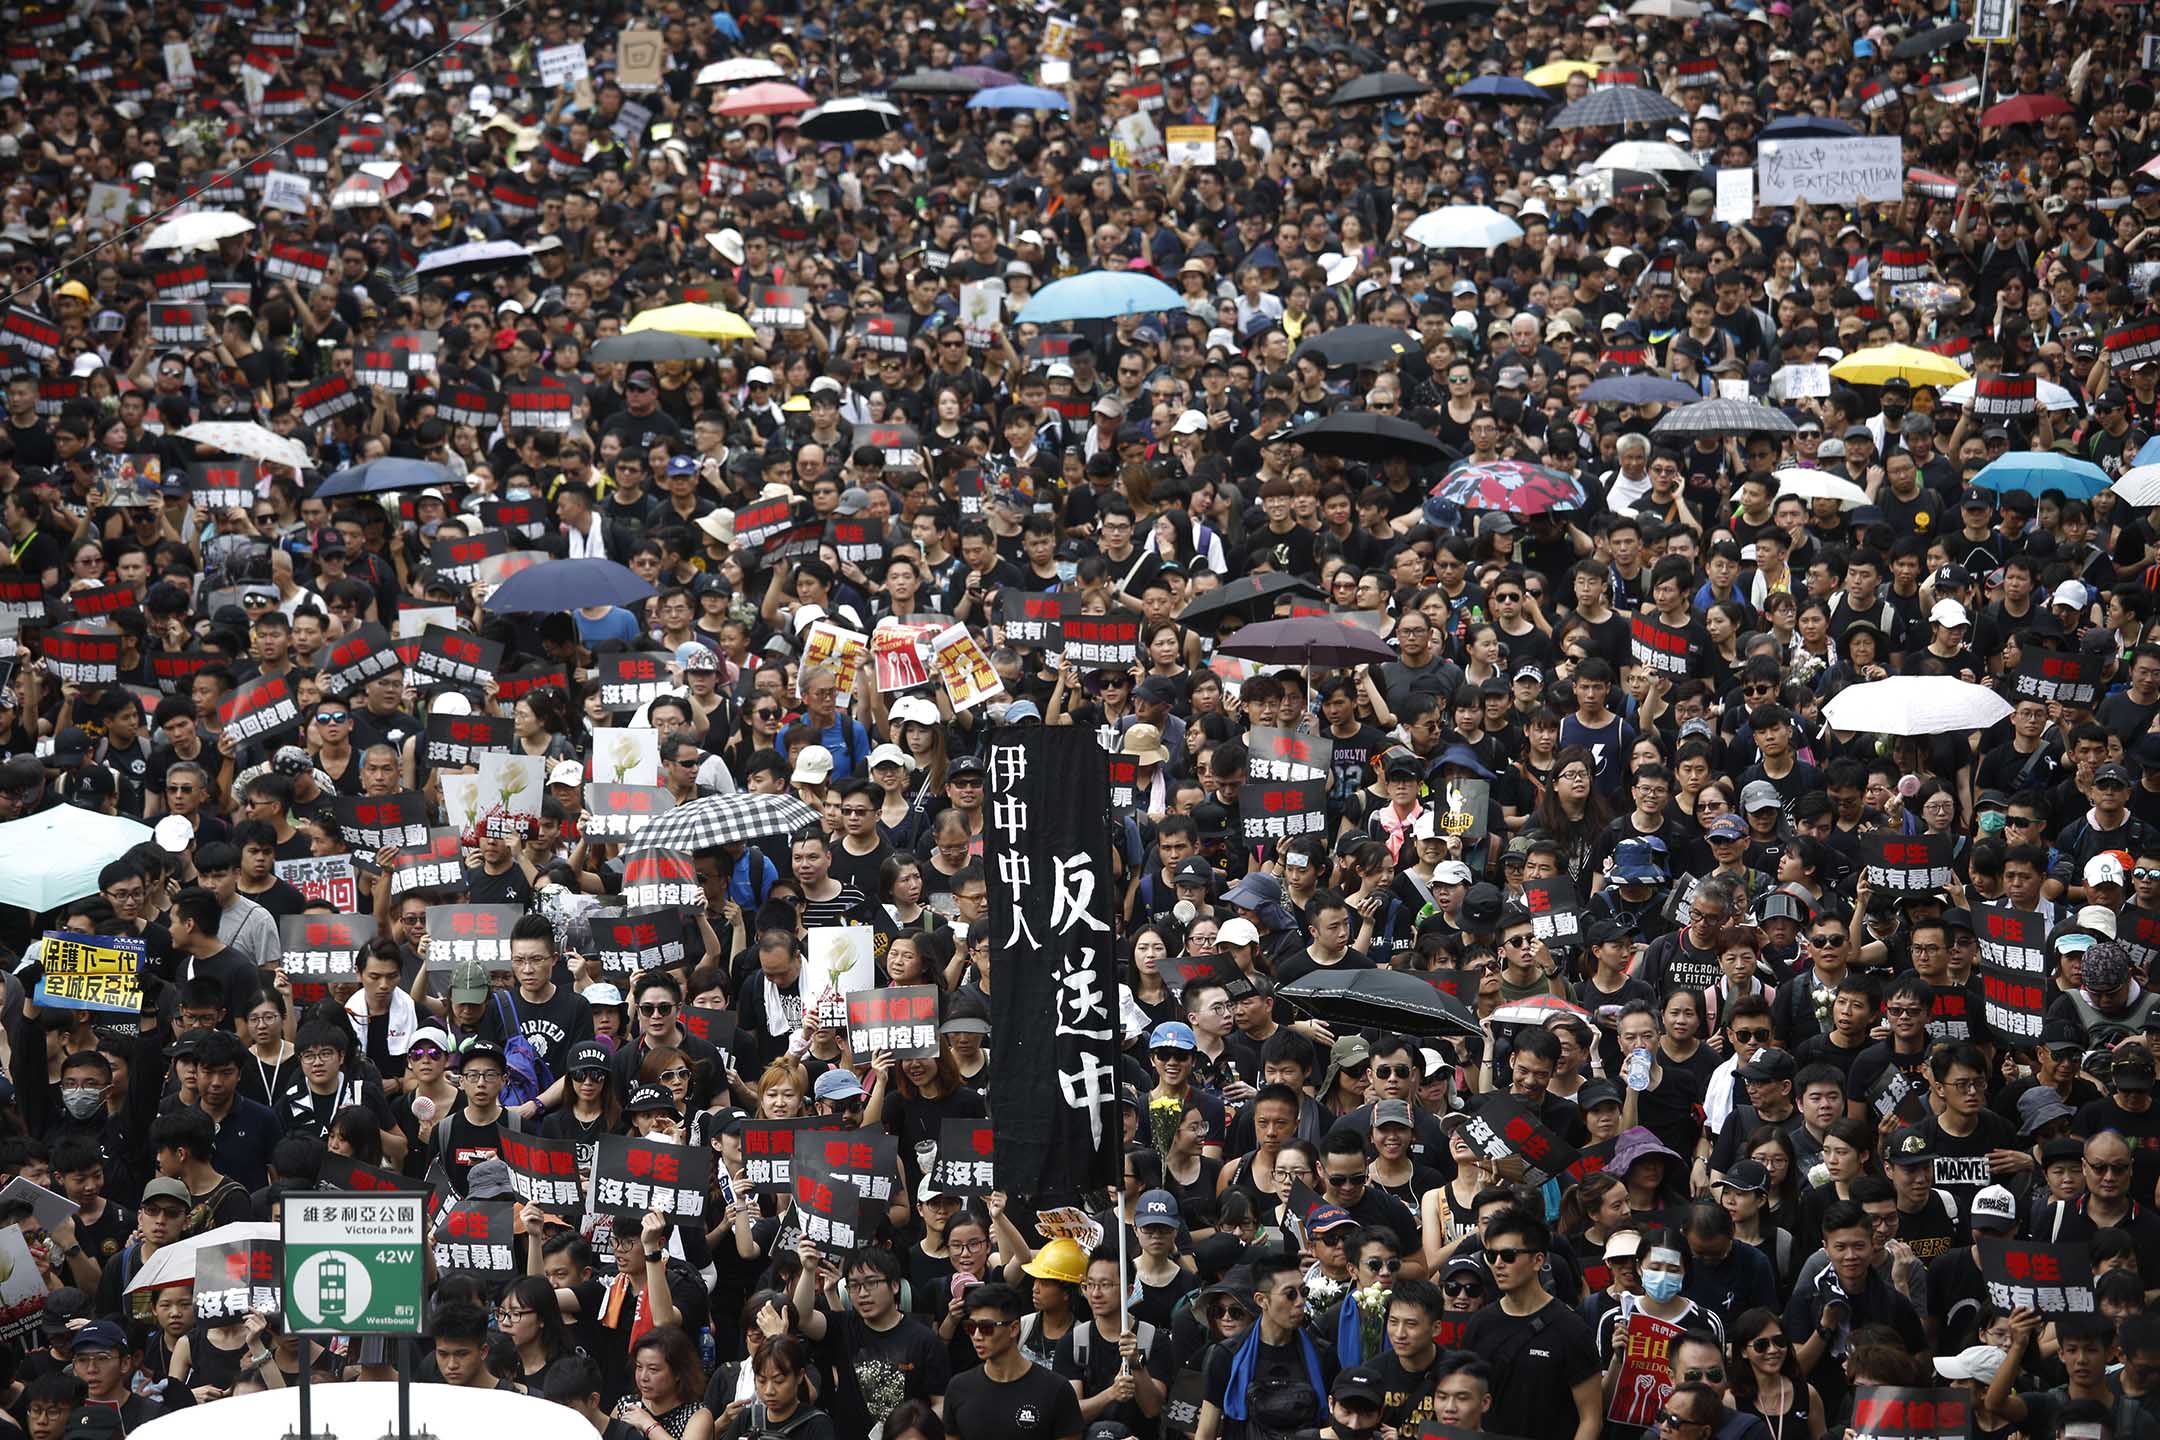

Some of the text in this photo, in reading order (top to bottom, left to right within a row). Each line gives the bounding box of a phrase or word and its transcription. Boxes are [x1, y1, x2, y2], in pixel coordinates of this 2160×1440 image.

[1065, 643, 1138, 663] 撤回控罪
[1334, 749, 1367, 763] OOKLYN
[341, 824, 428, 849] 沒有暴動
[1244, 811, 1325, 838] 沒有暴動
[1867, 865, 1952, 889] 沒有暴動
[1528, 889, 1551, 913] 生
[305, 923, 349, 945] 學生
[613, 923, 658, 947] 學生
[1532, 911, 1578, 940] 暴動
[43, 938, 137, 973] 保護下一代
[600, 940, 685, 971] 沒有暴動
[1685, 974, 1714, 985] FITCH
[820, 1003, 847, 1020] 反送
[1050, 851, 1115, 1152] 反送中
[1985, 1001, 2044, 1038] 撤回控罪
[851, 1024, 936, 1053] 撤回控罪
[579, 1049, 605, 1062] JORDAN
[745, 1129, 796, 1156] 問責
[972, 1130, 994, 1156] 學
[1465, 1116, 1512, 1160] 沒有
[627, 1149, 680, 1182] 學生
[824, 1141, 873, 1169] 學生
[746, 1160, 791, 1183] 撤回
[944, 1160, 994, 1188] 沒有
[1937, 1160, 1989, 1182] MARVEL
[597, 1178, 704, 1217] 沒有暴動
[1147, 1202, 1167, 1213] FOR
[303, 1206, 414, 1222] 維多利亞公園
[448, 1211, 489, 1238] 學生
[345, 1226, 414, 1235] Victoria Park
[225, 1250, 272, 1280] 學生
[375, 1250, 415, 1264] 42W
[2005, 1251, 2062, 1281] 學生
[197, 1286, 281, 1319] 沒有暴
[1987, 1281, 2094, 1312] 沒有暴動
[366, 1316, 414, 1325] Westbound
